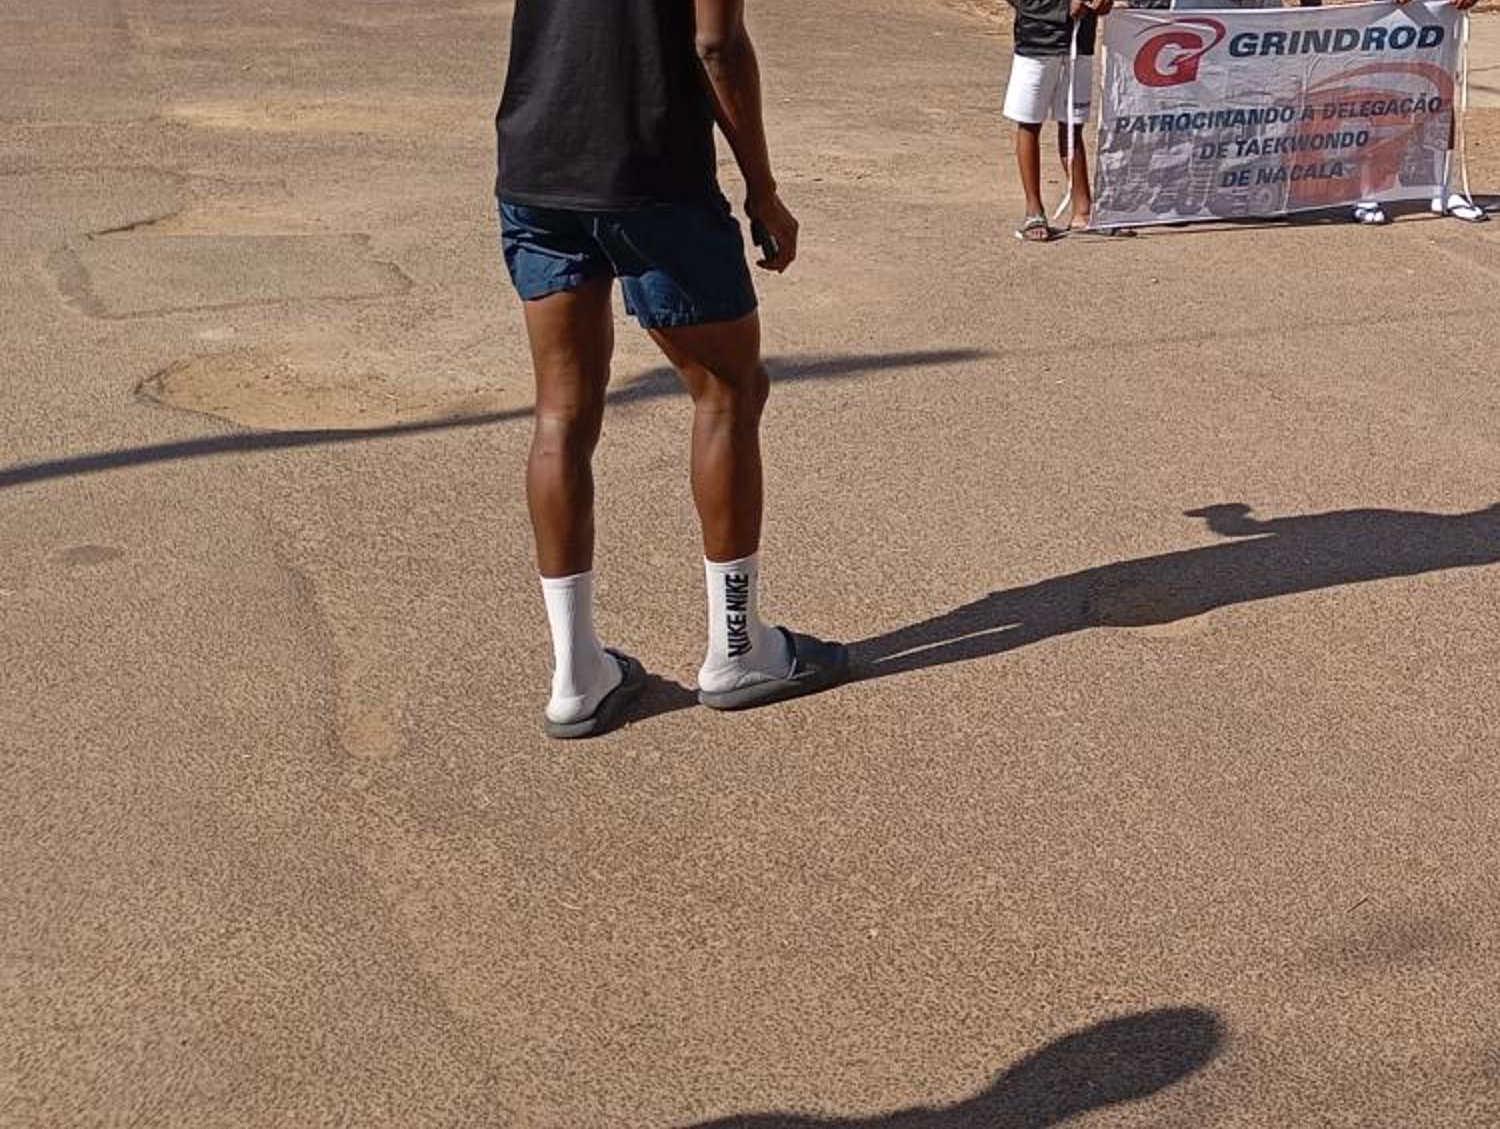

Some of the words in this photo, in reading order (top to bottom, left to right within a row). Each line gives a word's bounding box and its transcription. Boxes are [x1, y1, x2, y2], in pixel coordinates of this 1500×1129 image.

[1229, 24, 1445, 58] GRINDROD
[1115, 106, 1295, 134] PATROCINANDO
[1199, 142, 1230, 160] DE
[1235, 130, 1370, 158] TAEKWONDO
[1221, 170, 1249, 188] DE
[1255, 161, 1344, 185] NACALA
[725, 573, 749, 611] NIKE
[726, 614, 752, 658] NIKE
